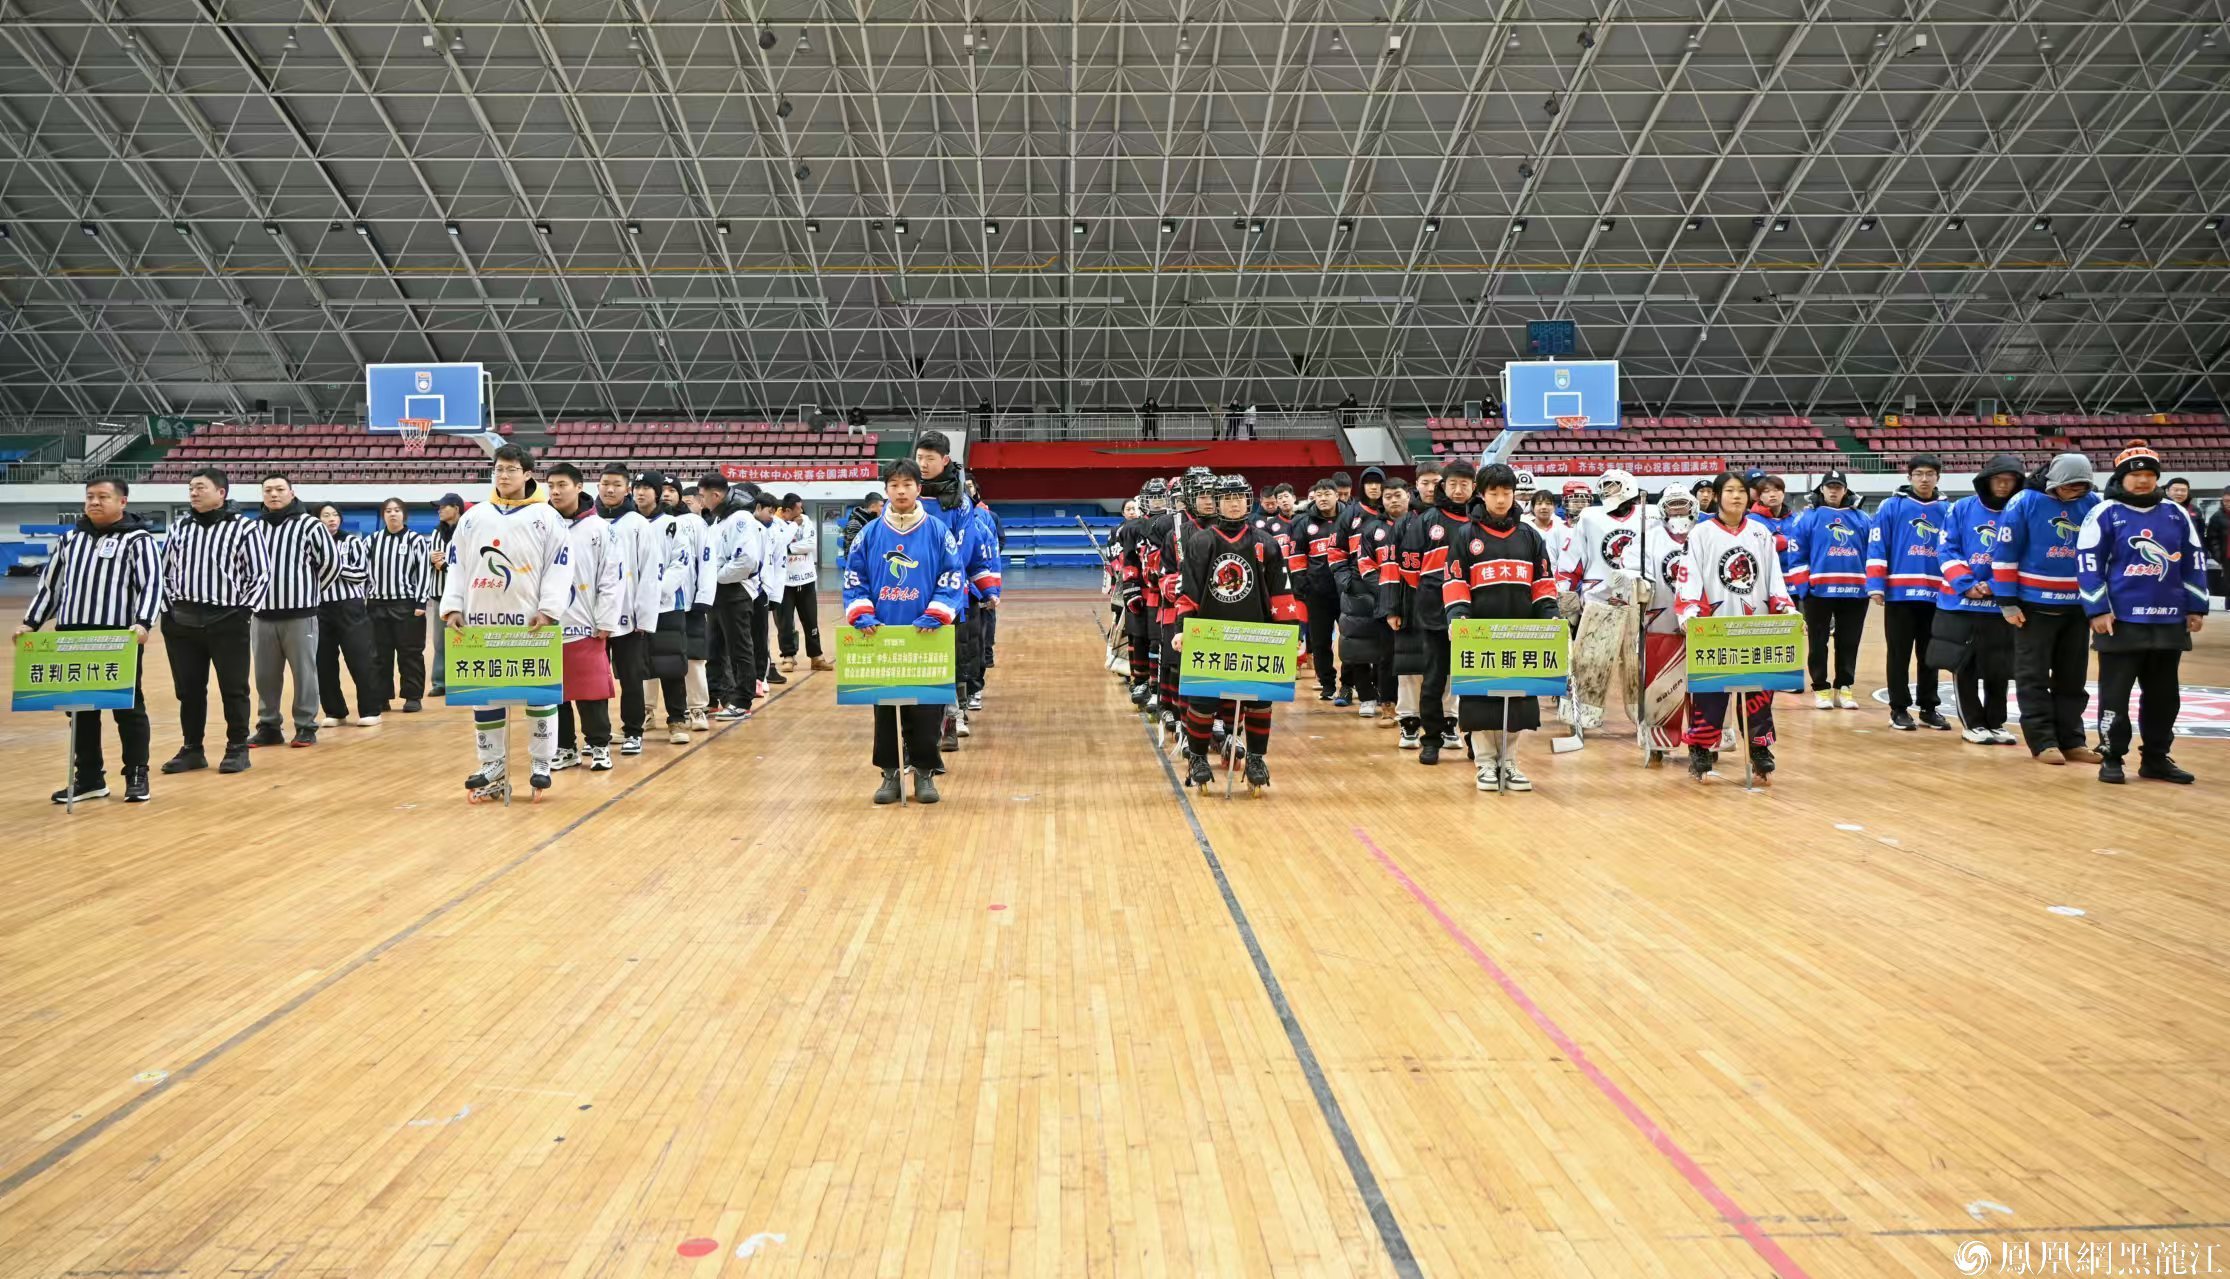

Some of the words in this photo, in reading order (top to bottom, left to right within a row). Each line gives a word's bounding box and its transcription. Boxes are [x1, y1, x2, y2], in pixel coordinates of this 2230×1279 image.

[1402, 552, 1420, 568] 35
[2077, 553, 2097, 573] 15
[1444, 560, 1462, 580] 14
[1481, 564, 1528, 580] 佳木斯
[937, 571, 962, 590] 85
[1192, 650, 1285, 675] 齐齐哈尔女队
[1460, 650, 1558, 669] 佳木斯男队
[1695, 645, 1795, 666] 齐齐哈尔兰迪俱乐部
[30, 662, 119, 683] 裁判员代表
[456, 658, 551, 677] 齐齐哈尔男队
